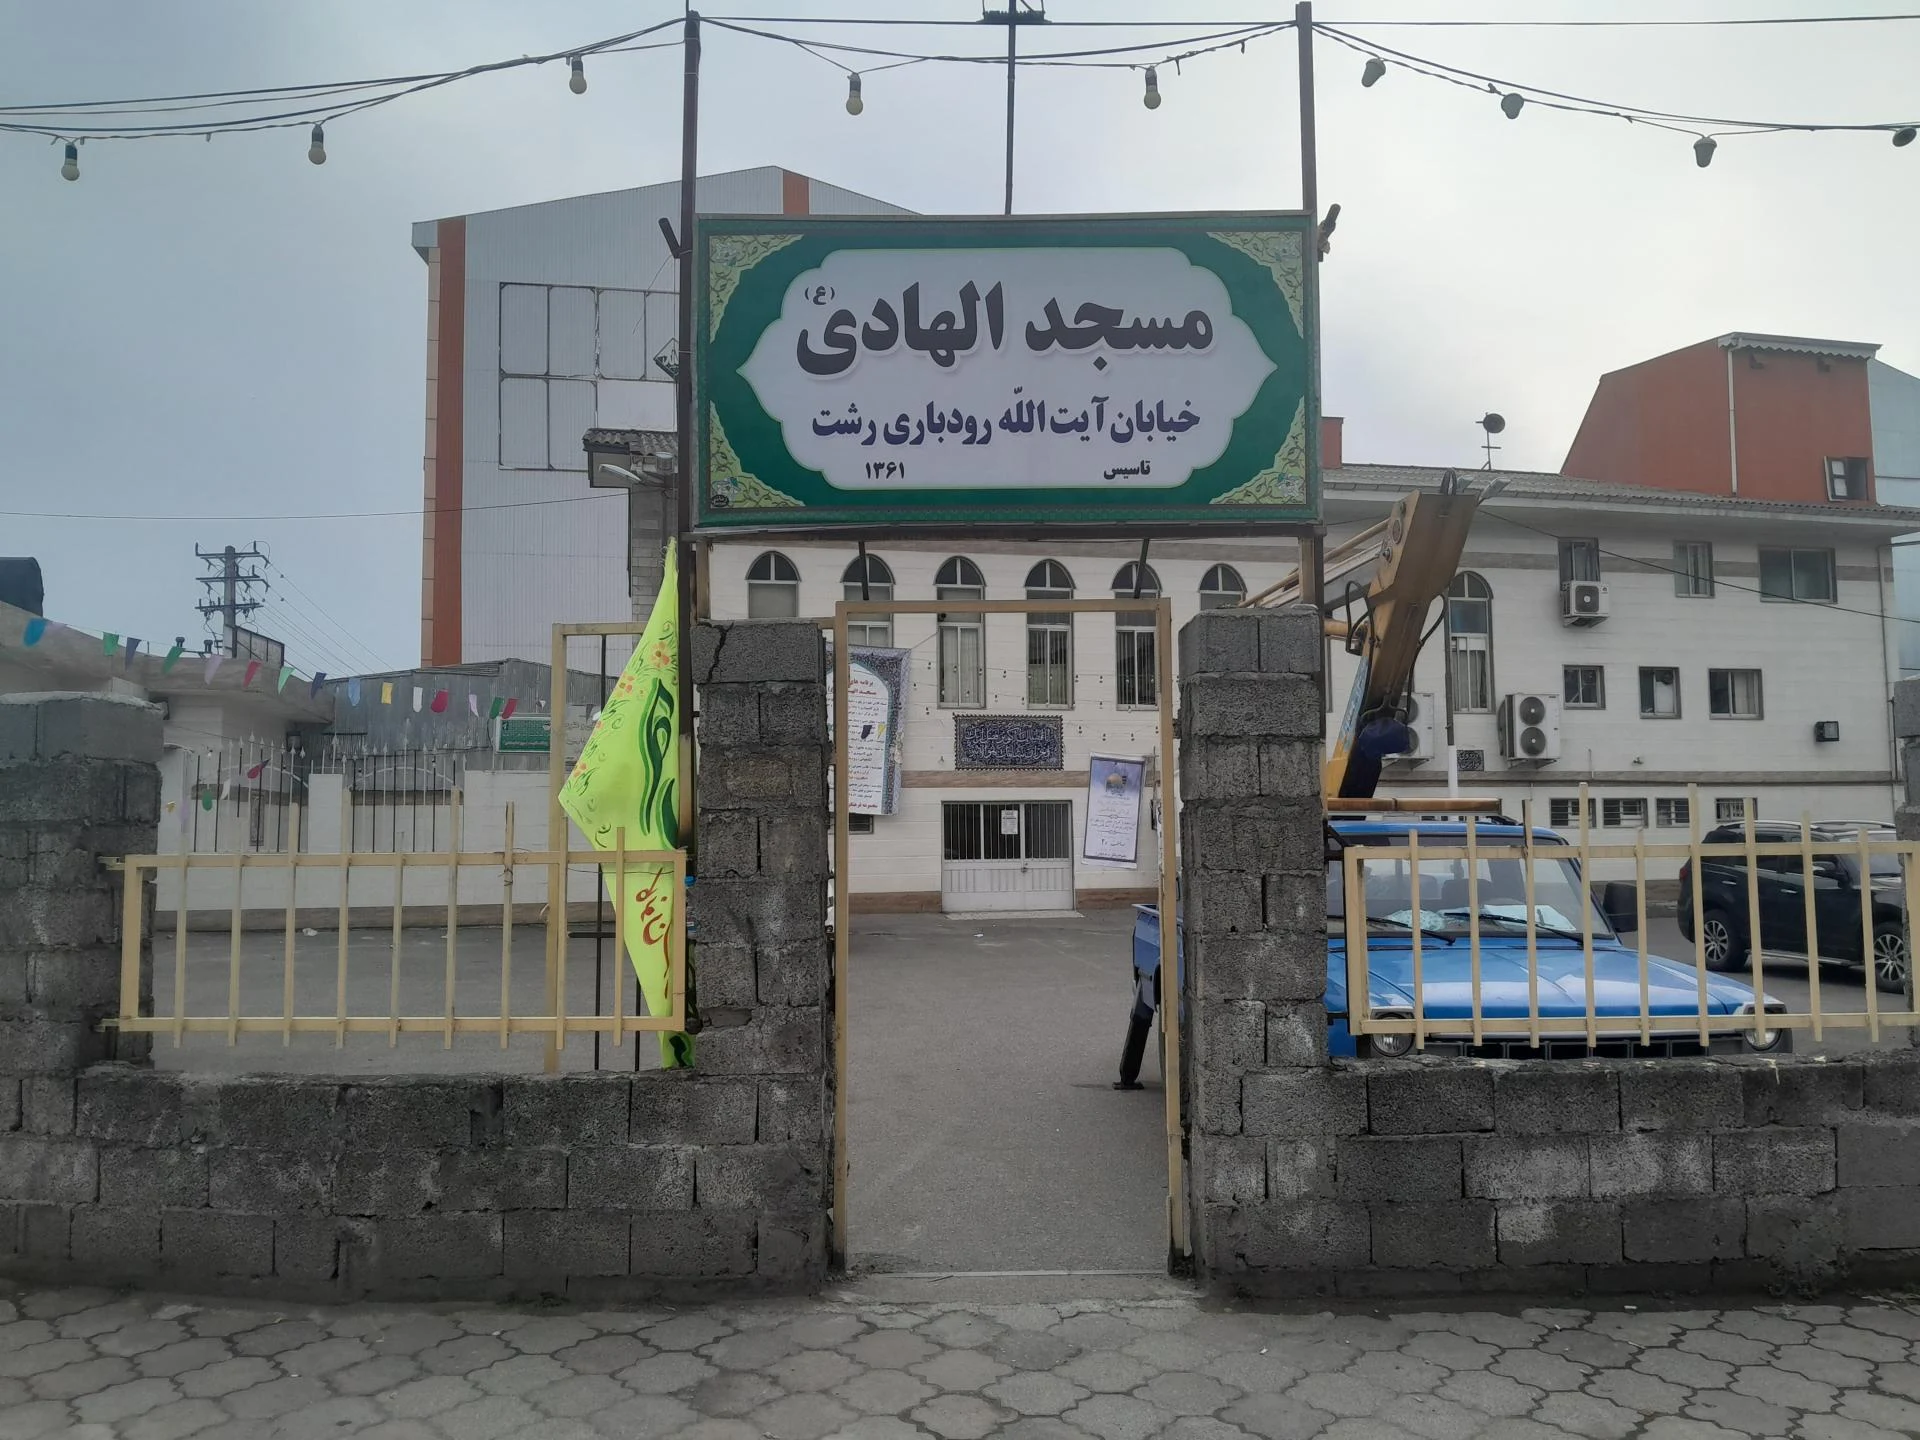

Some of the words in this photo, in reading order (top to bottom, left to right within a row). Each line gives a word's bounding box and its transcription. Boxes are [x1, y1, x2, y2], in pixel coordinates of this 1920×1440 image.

[804, 285, 835, 306] (ع)
[797, 280, 1004, 375] الهادی
[1025, 297, 1214, 371] مسجد
[812, 402, 877, 445] رشت
[883, 401, 992, 445] رودباری
[1050, 395, 1110, 442] آیت
[1110, 399, 1201, 443] خیابان
[865, 461, 905, 480] ۱۳۶۱
[1103, 459, 1151, 480] تاسیس
